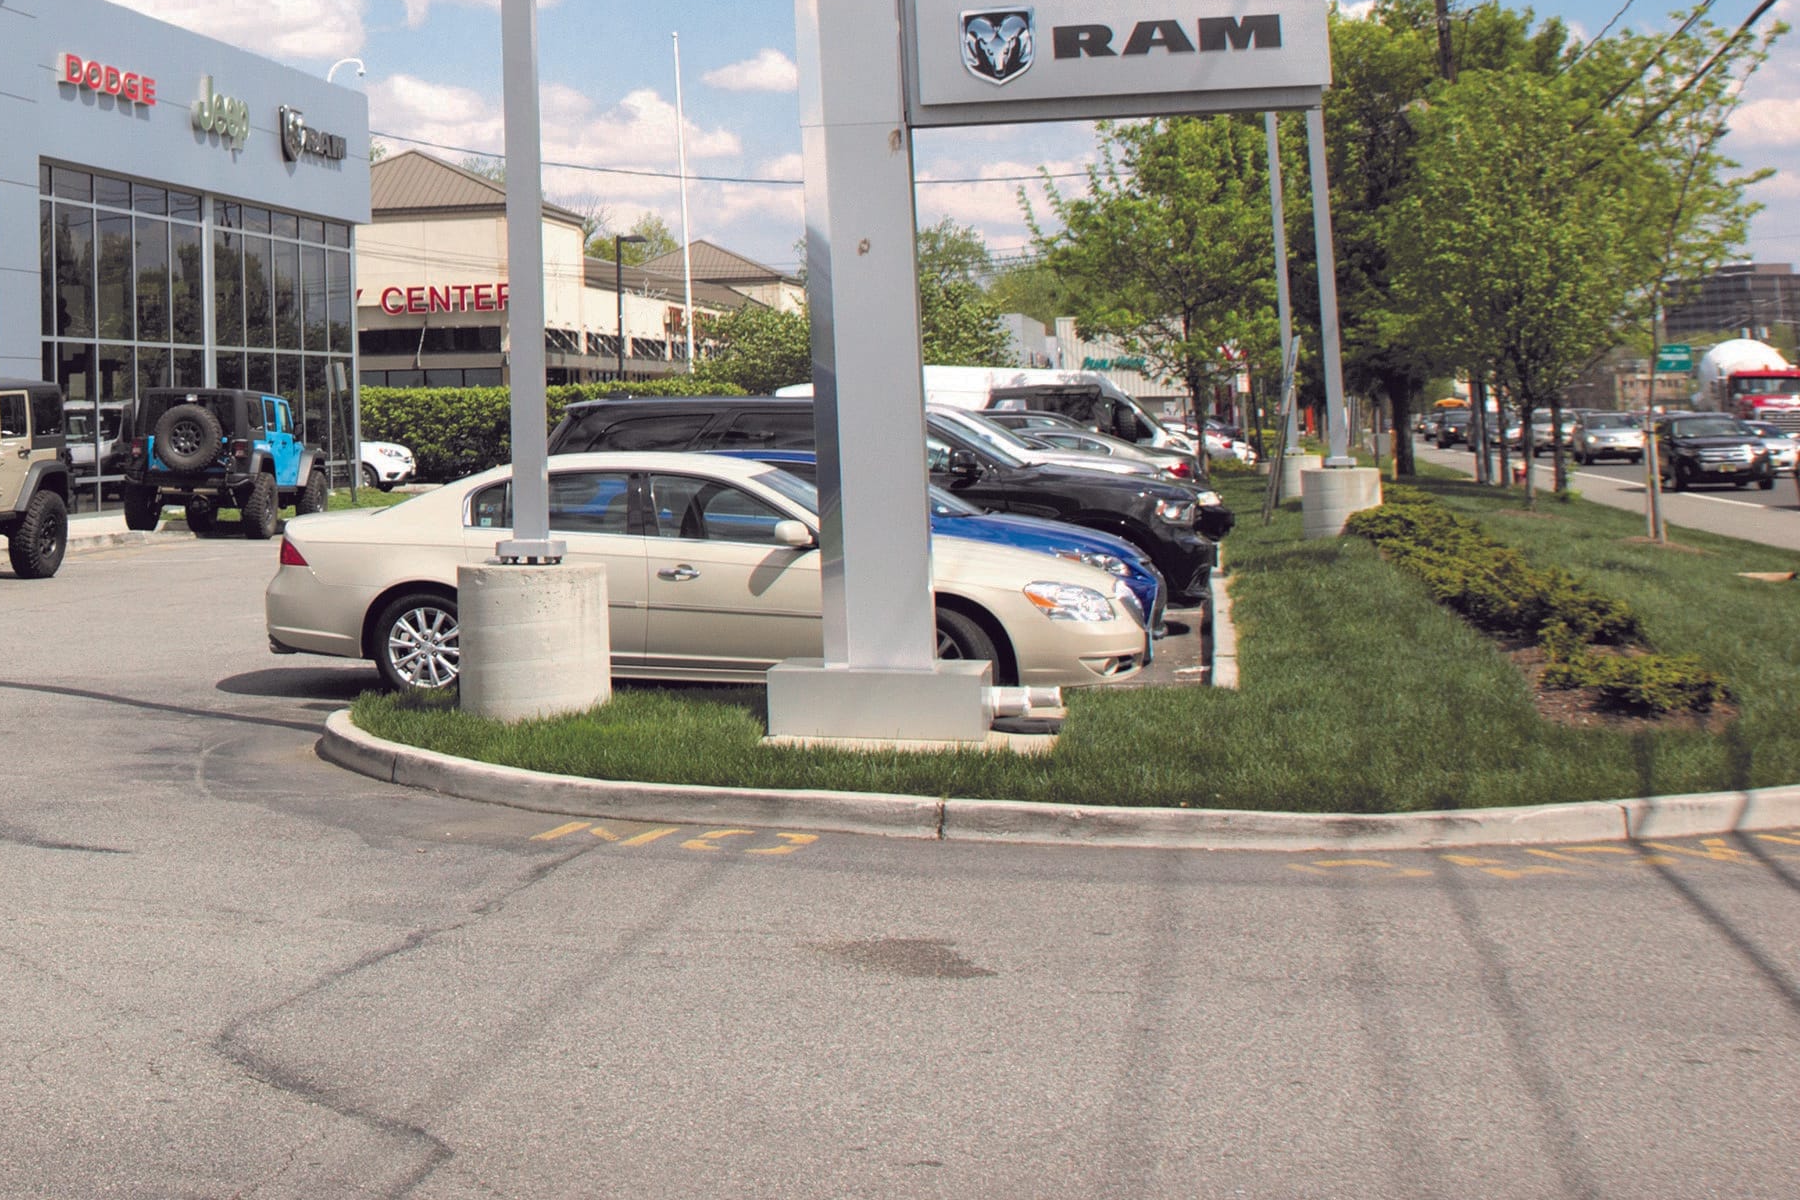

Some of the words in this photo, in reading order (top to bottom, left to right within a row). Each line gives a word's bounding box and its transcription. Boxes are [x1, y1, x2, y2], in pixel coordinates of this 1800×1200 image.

[1052, 13, 1282, 60] RAM
[61, 53, 157, 106] DODGE
[192, 75, 250, 150] Jeep
[305, 127, 347, 160] RAM
